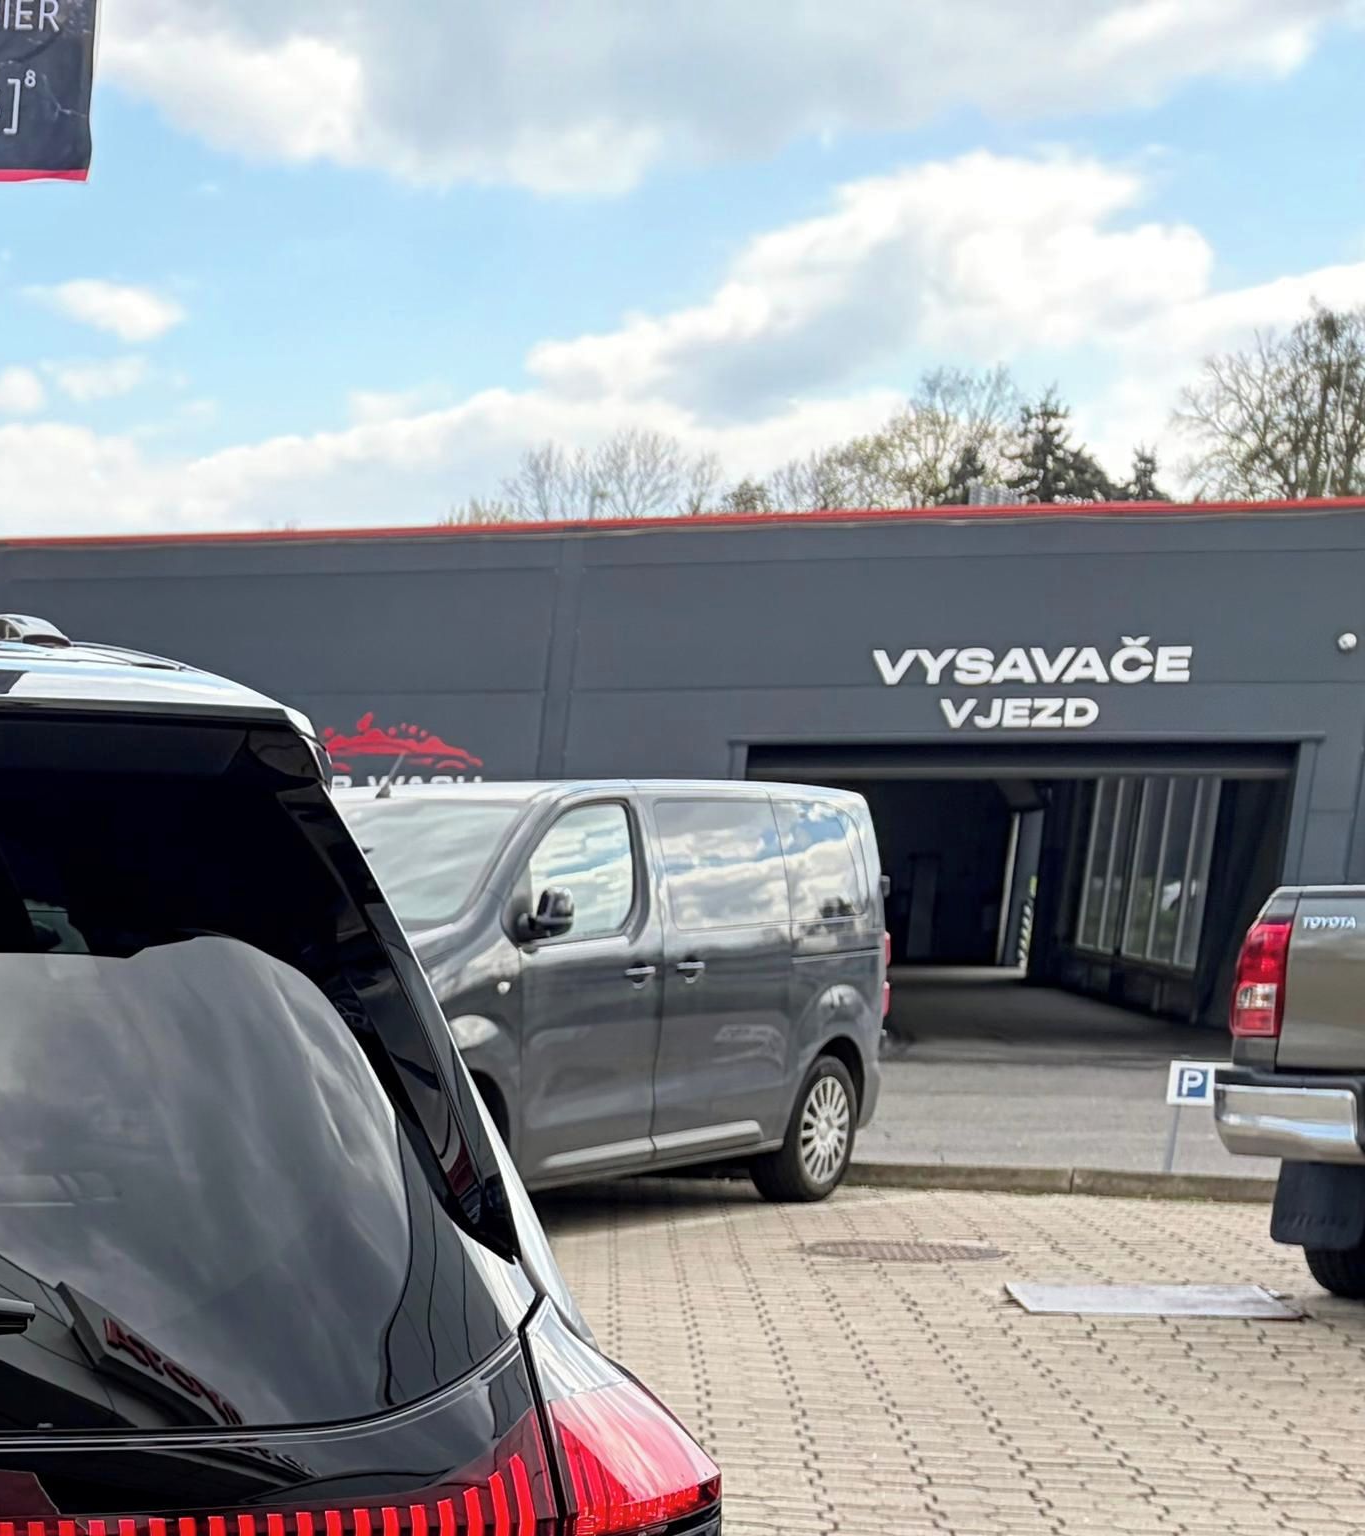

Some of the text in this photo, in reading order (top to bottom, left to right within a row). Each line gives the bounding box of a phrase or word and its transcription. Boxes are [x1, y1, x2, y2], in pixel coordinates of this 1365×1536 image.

[872, 635, 1193, 685] VYSAVAČE
[940, 697, 1099, 729] VJEZD
[1302, 916, 1356, 929] TOYOTA
[1181, 1070, 1204, 1097] P
